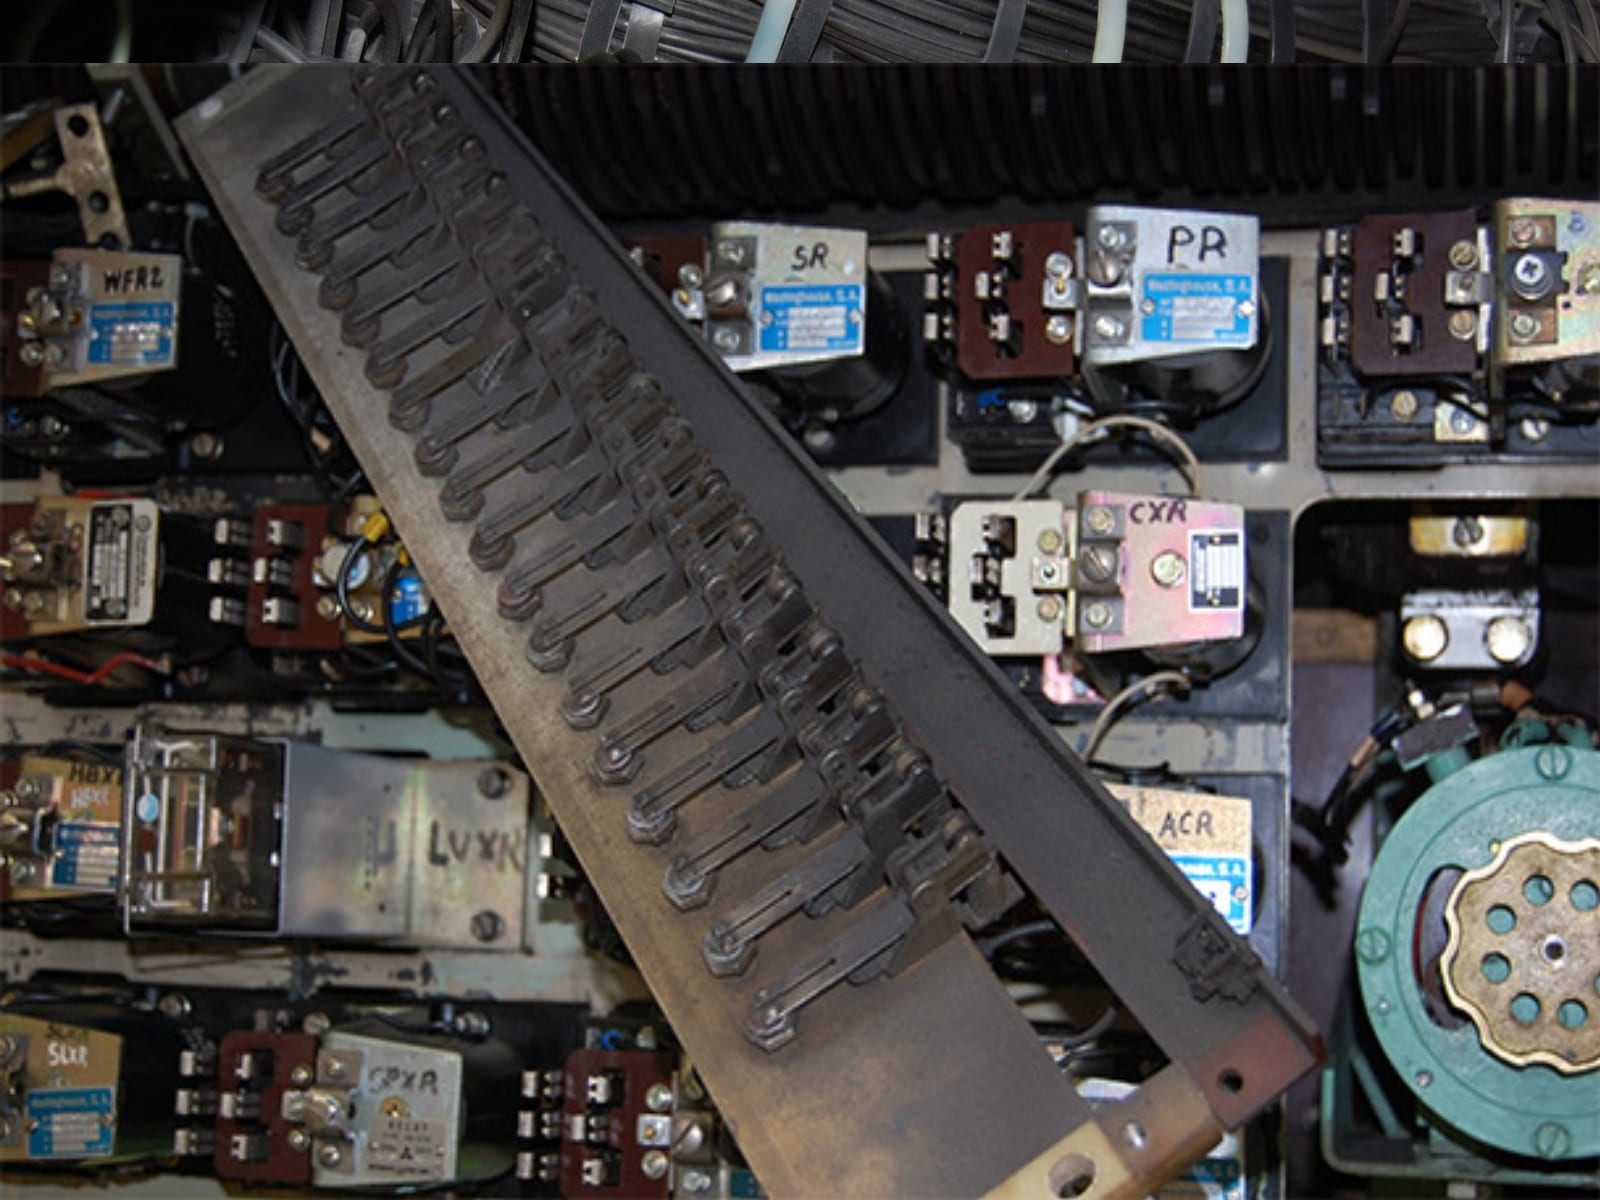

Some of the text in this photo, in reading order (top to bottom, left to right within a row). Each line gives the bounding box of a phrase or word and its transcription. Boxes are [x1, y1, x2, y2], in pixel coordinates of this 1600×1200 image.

[791, 241, 829, 272] SR
[1167, 224, 1227, 264] PR
[104, 266, 164, 294] WFR2
[1129, 498, 1187, 525] CXR
[1159, 810, 1215, 838] ACR
